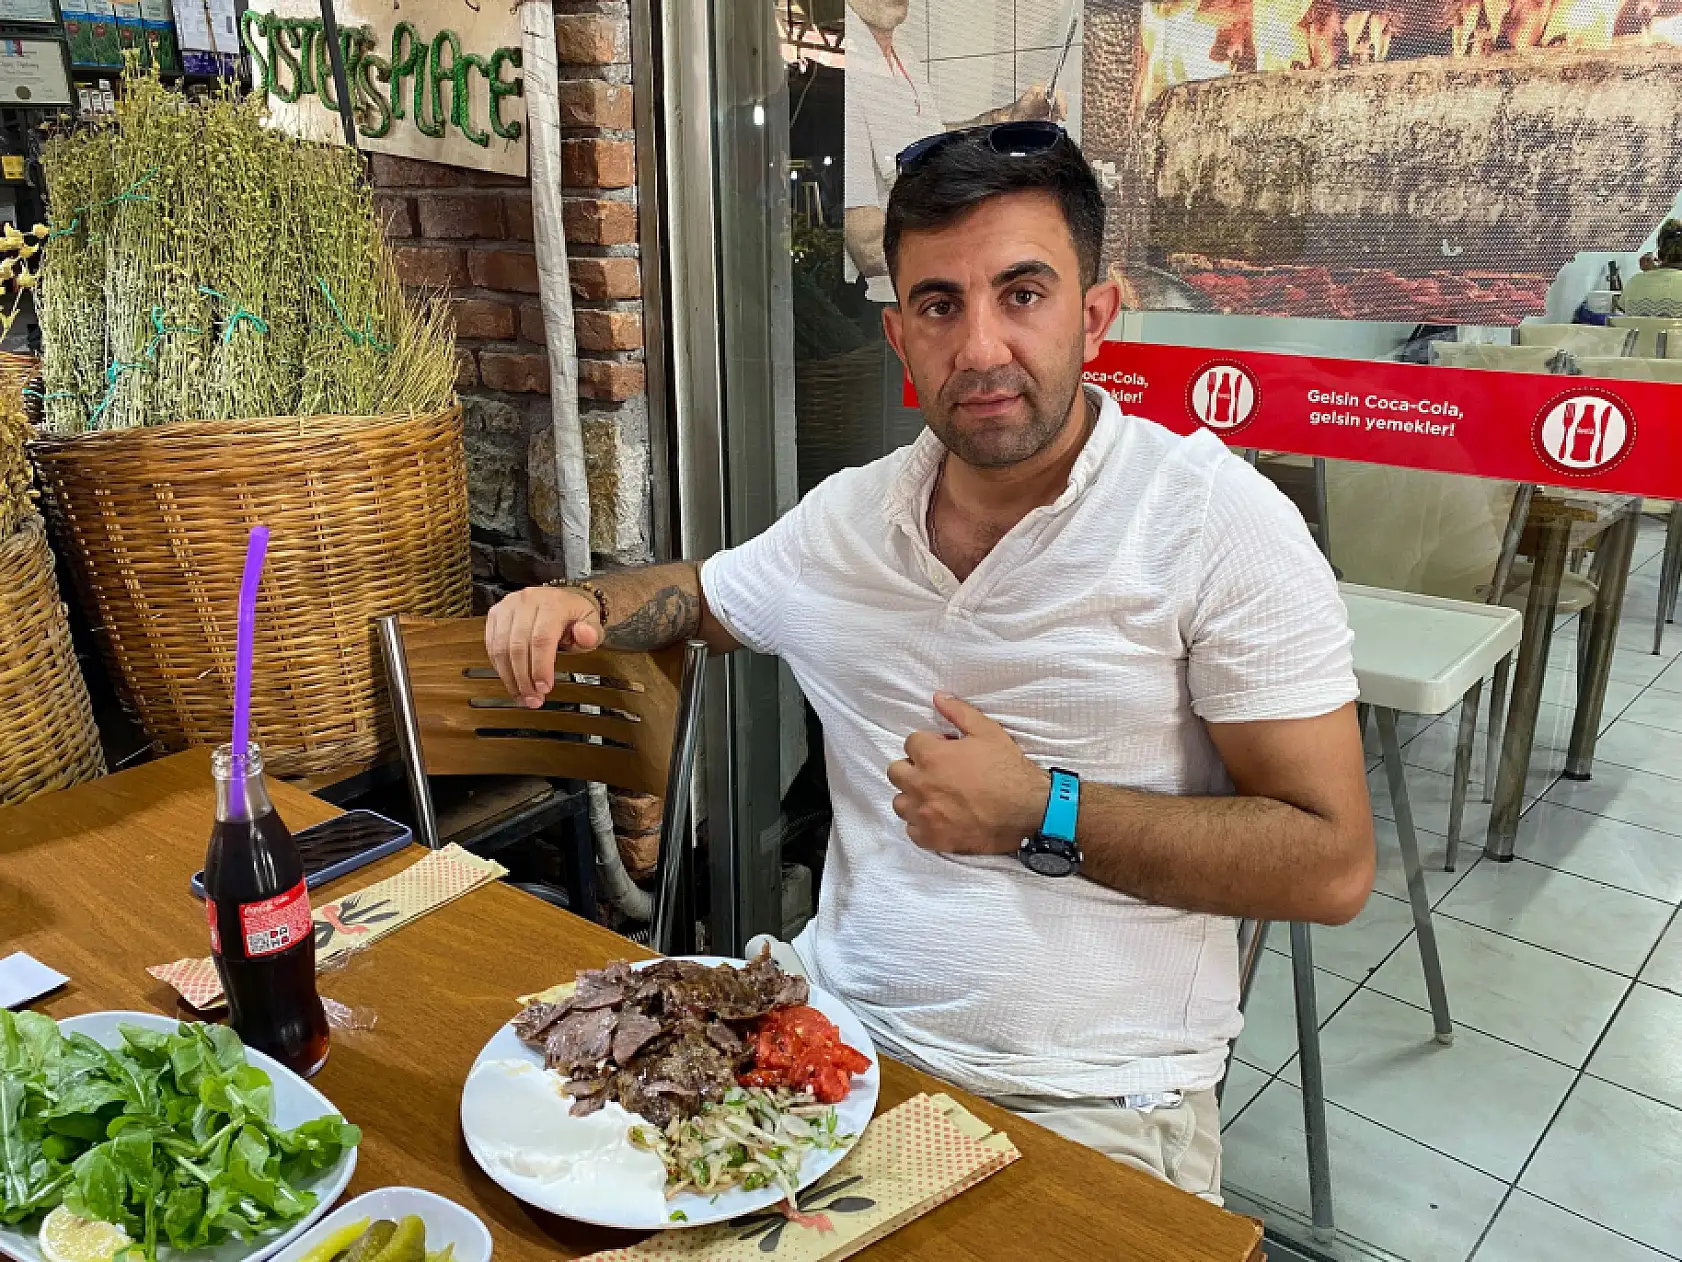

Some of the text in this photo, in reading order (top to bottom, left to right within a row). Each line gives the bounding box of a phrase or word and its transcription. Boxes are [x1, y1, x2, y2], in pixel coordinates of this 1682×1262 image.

[390, 22, 523, 147] PLACE
[1082, 371, 1149, 388] oca-Cola,
[1110, 388, 1143, 403] kler!
[1307, 389, 1464, 420] Gelsin Coca-Cola,
[1309, 410, 1456, 437] gelsin yemekler!
